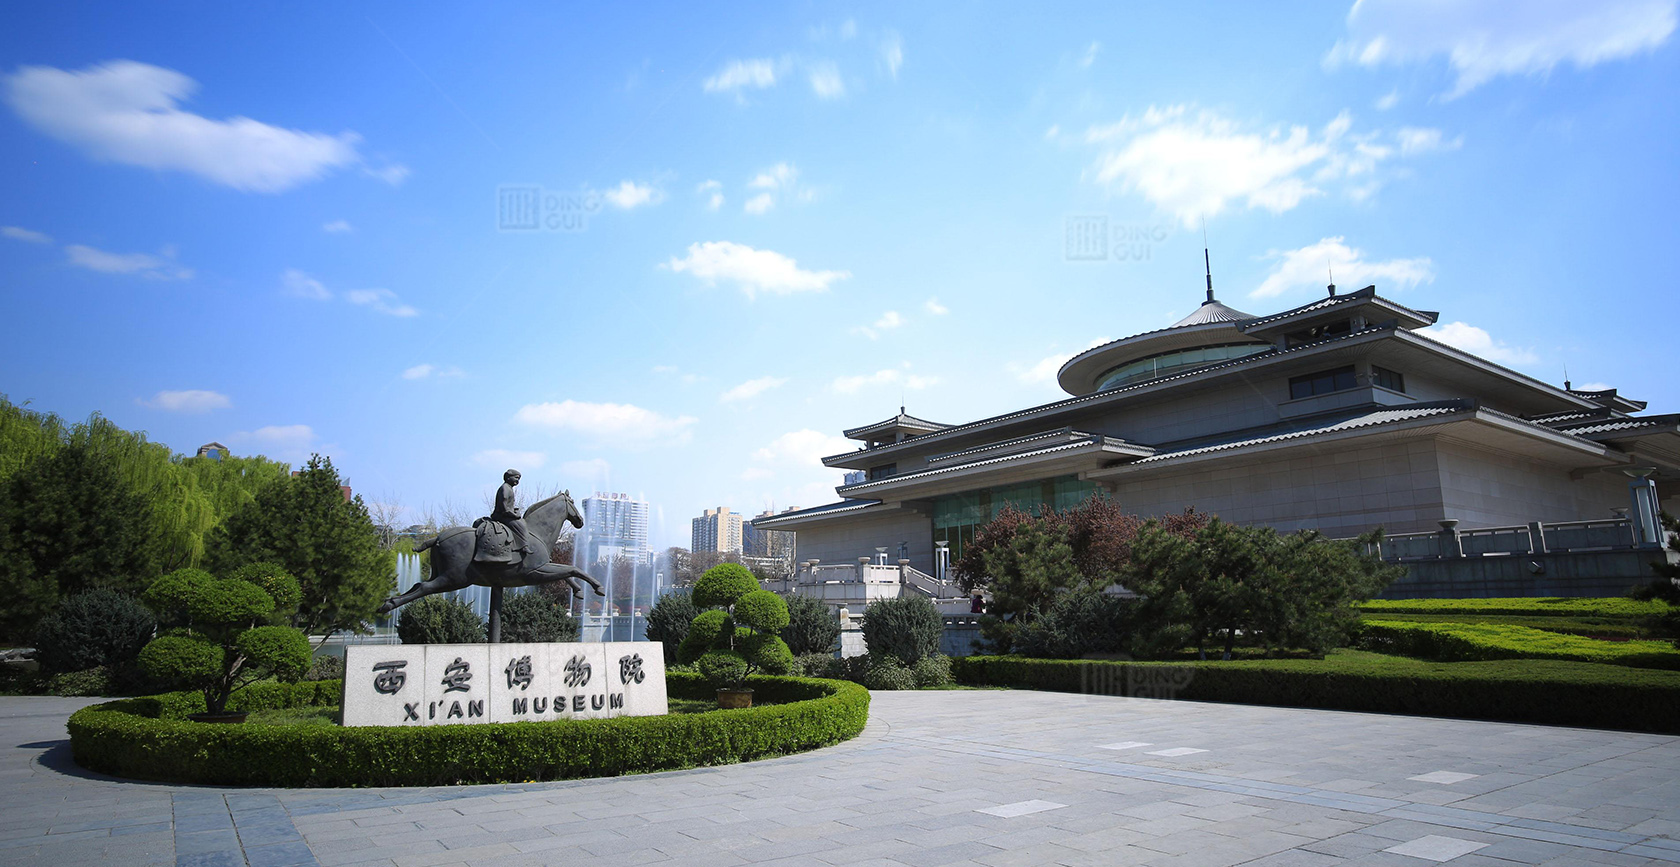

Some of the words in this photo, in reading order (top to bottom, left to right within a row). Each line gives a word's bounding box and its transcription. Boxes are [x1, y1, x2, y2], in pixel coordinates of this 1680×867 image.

[372, 653, 646, 696] 西安博物院
[403, 699, 484, 722] XI'AN
[512, 692, 624, 715] MUSEUM
